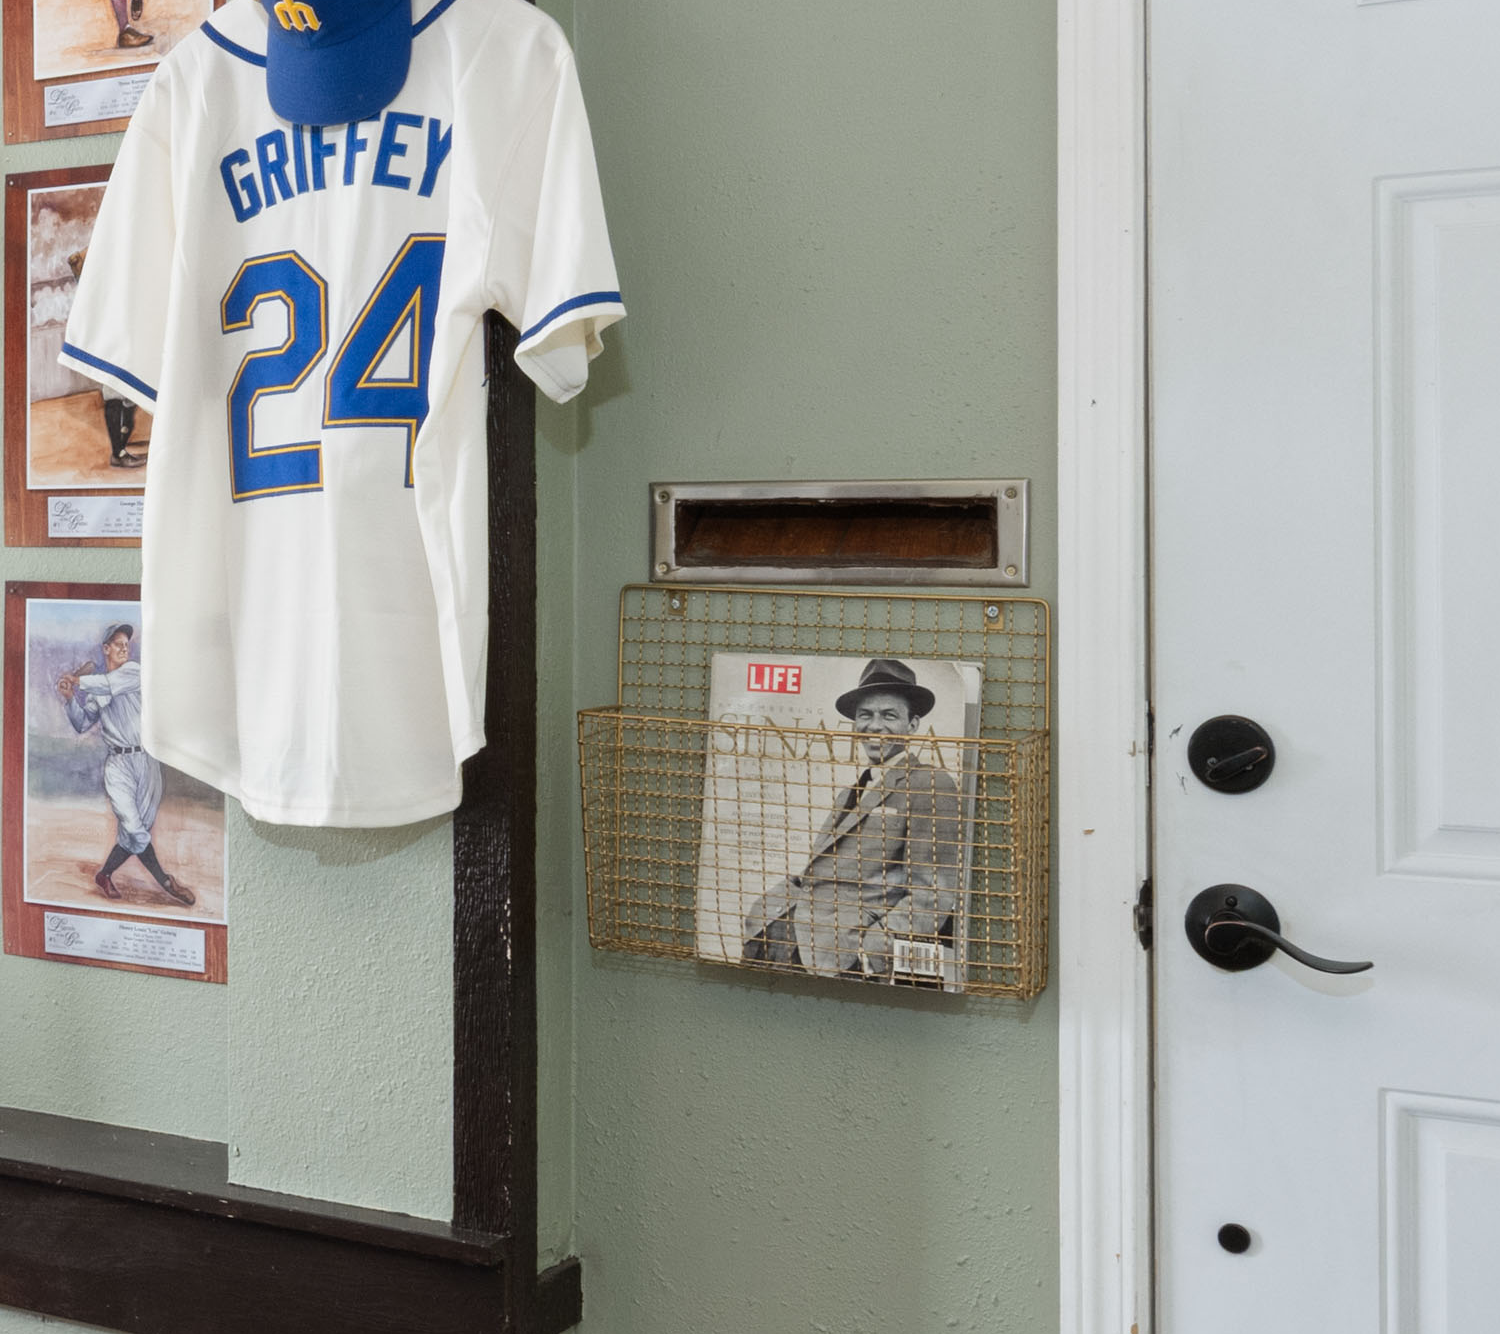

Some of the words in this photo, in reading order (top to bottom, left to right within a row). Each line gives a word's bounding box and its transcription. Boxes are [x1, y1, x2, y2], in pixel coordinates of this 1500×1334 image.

[220, 110, 453, 223] GRIFFEY
[220, 232, 447, 504] 24
[750, 665, 799, 692] LIFE
[715, 712, 949, 769] SINATA
